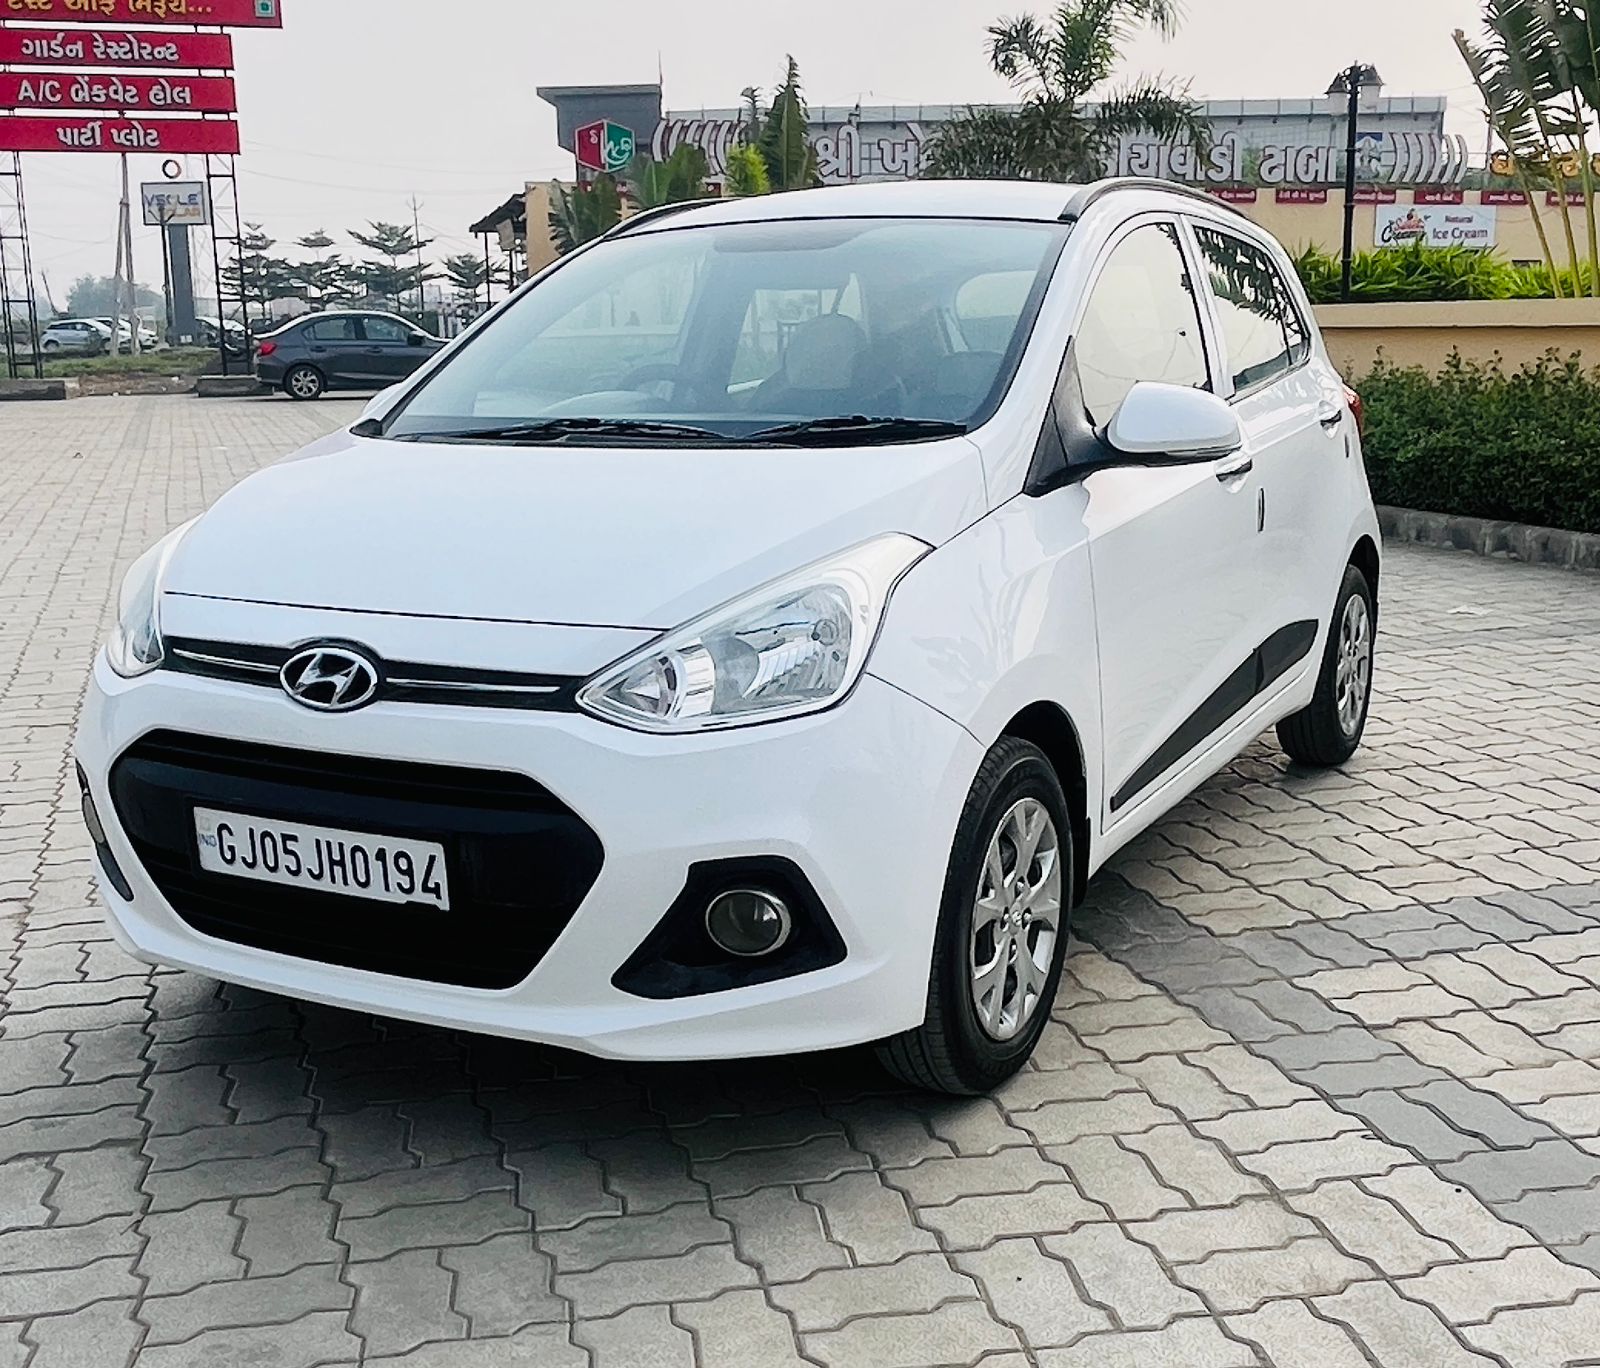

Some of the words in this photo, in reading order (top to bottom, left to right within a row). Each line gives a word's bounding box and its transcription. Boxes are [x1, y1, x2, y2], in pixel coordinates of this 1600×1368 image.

[21, 32, 84, 59] ગાર્ડન
[18, 79, 62, 102] A/C
[149, 77, 192, 105] હોલ
[56, 121, 103, 147] પાર્ટી
[110, 120, 161, 147] પ્લોટ
[1444, 215, 1474, 224] Natural
[1432, 228, 1449, 240] Ice
[1451, 227, 1489, 240] Cream
[216, 822, 443, 900] GJ05JH0194
